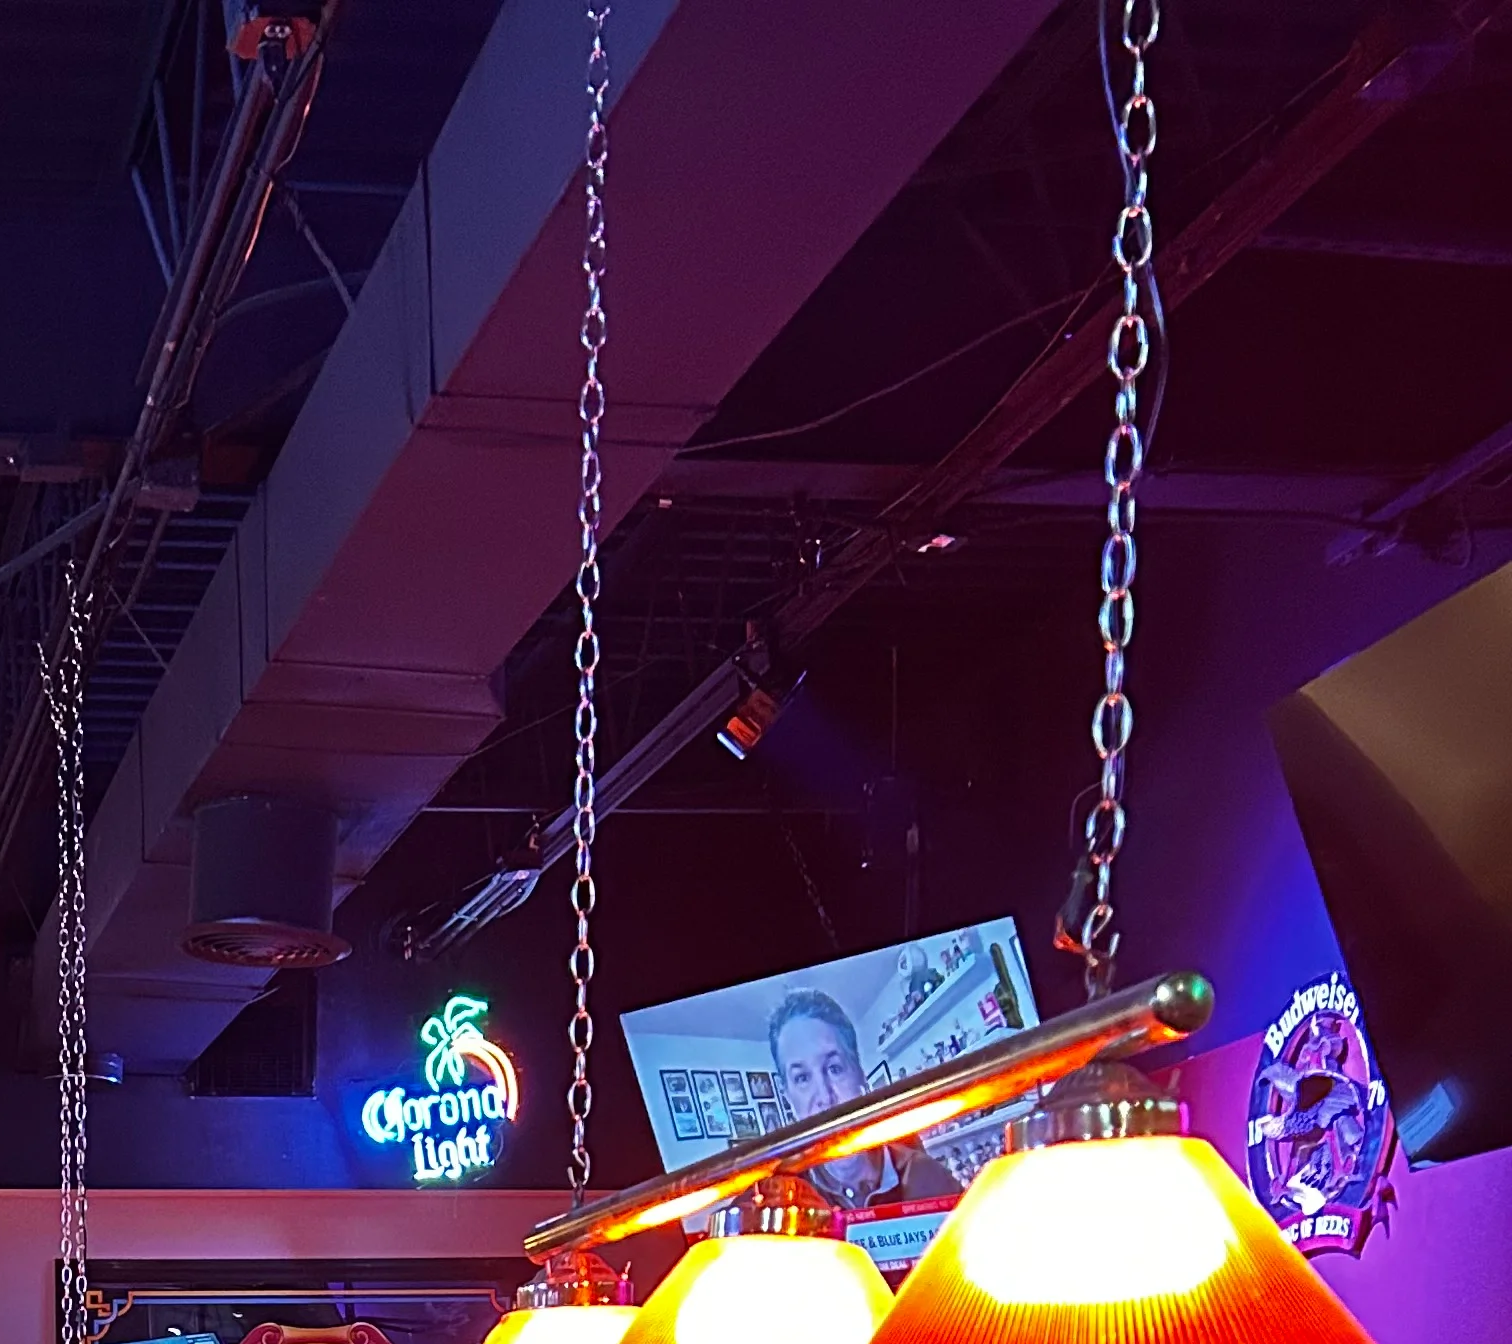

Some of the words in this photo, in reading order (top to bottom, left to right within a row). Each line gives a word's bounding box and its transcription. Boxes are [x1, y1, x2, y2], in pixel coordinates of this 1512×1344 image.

[1264, 971, 1359, 1058] Budweiser
[362, 1085, 506, 1143] Corona
[412, 1124, 496, 1181] Light
[877, 1233, 903, 1248] BLUE
[904, 1230, 927, 1245] JAYS
[1315, 1215, 1351, 1237] BEERS
